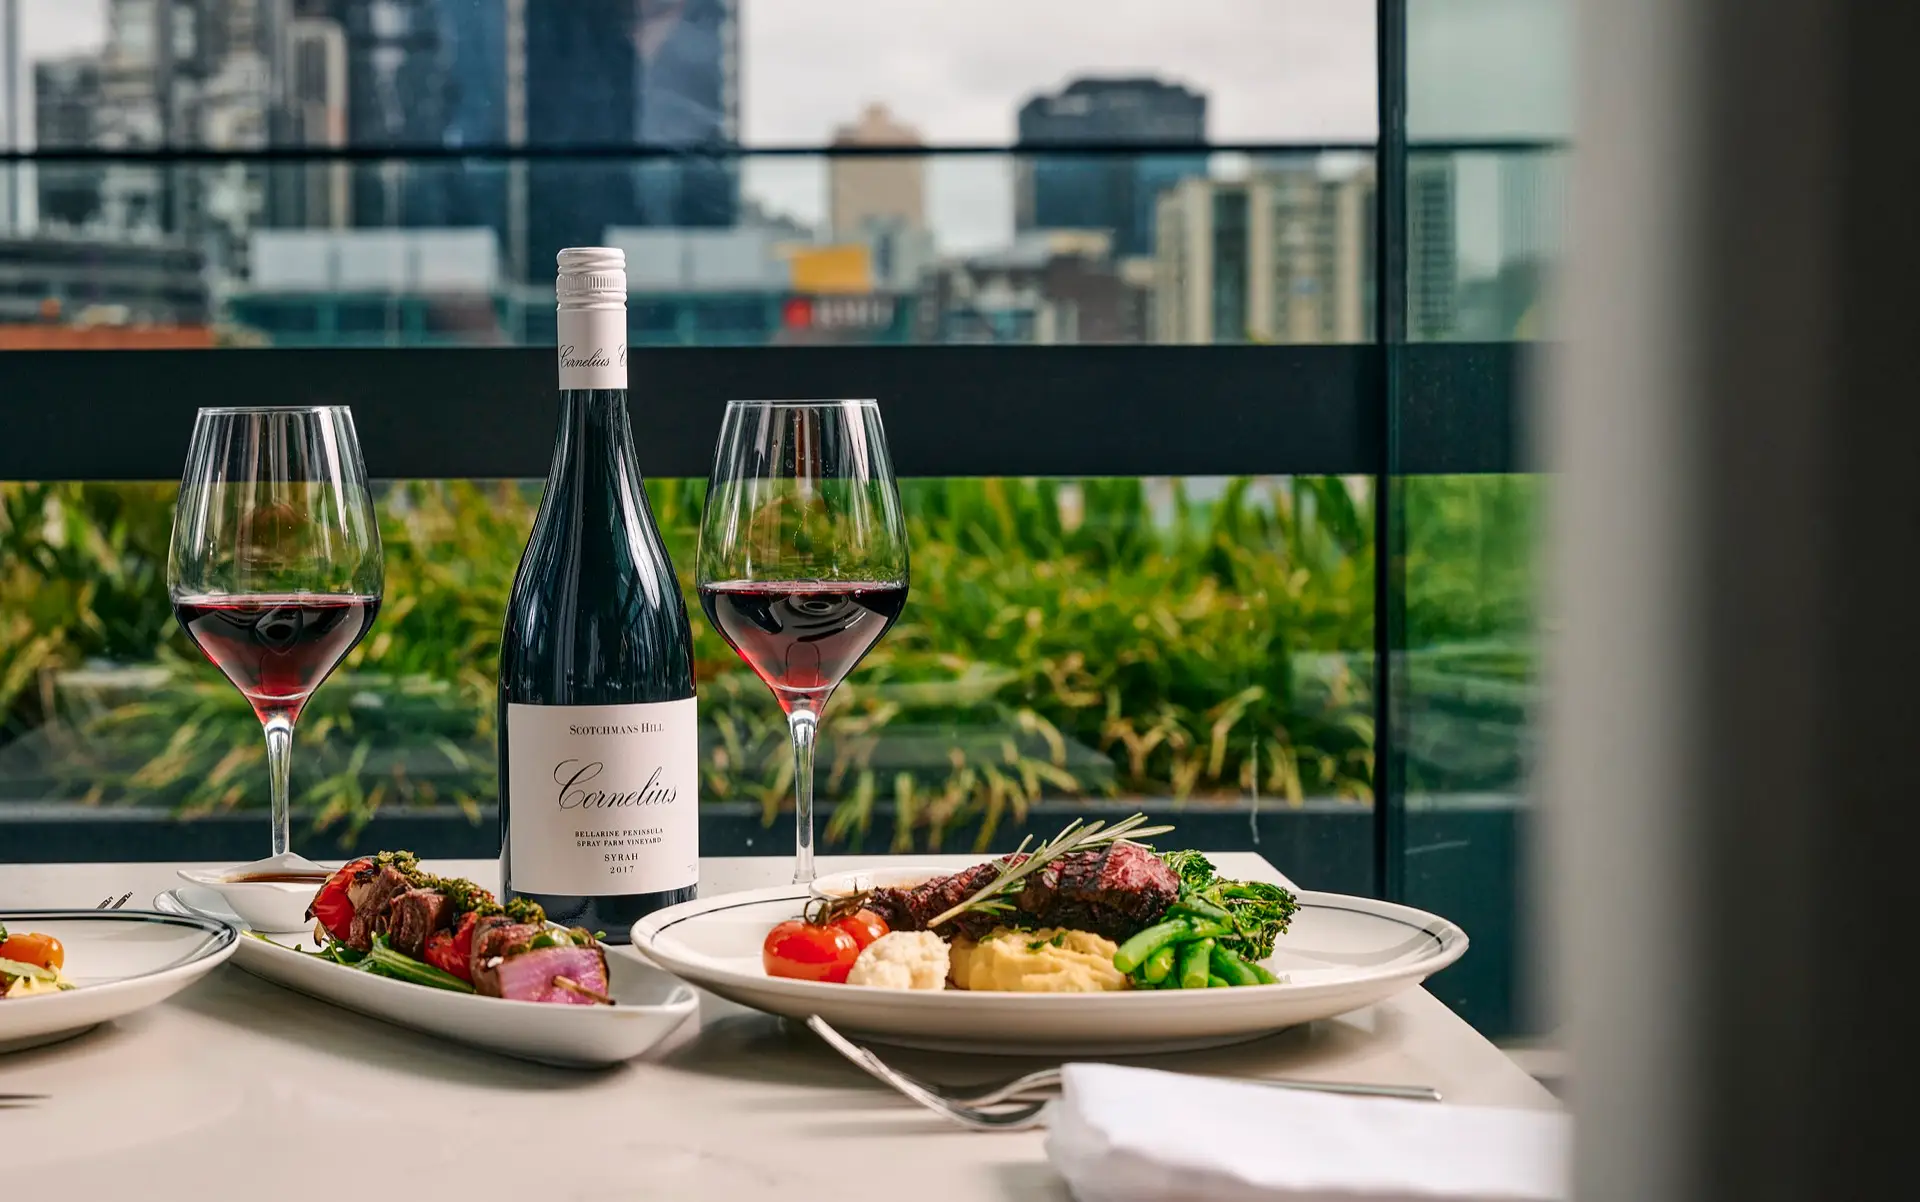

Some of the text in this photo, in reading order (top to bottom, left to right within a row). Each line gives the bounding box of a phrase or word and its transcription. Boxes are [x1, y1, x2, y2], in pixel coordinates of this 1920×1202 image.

[559, 344, 610, 368] Cornelius
[569, 722, 664, 736] SCOTCHMANS HILL
[553, 758, 678, 812] Cornelius
[574, 827, 664, 838] BELLARINE PENINSULA
[576, 836, 662, 847] SPRAY FARM VINEYARD
[604, 852, 639, 862] SYRAH
[609, 865, 635, 874] 2017
